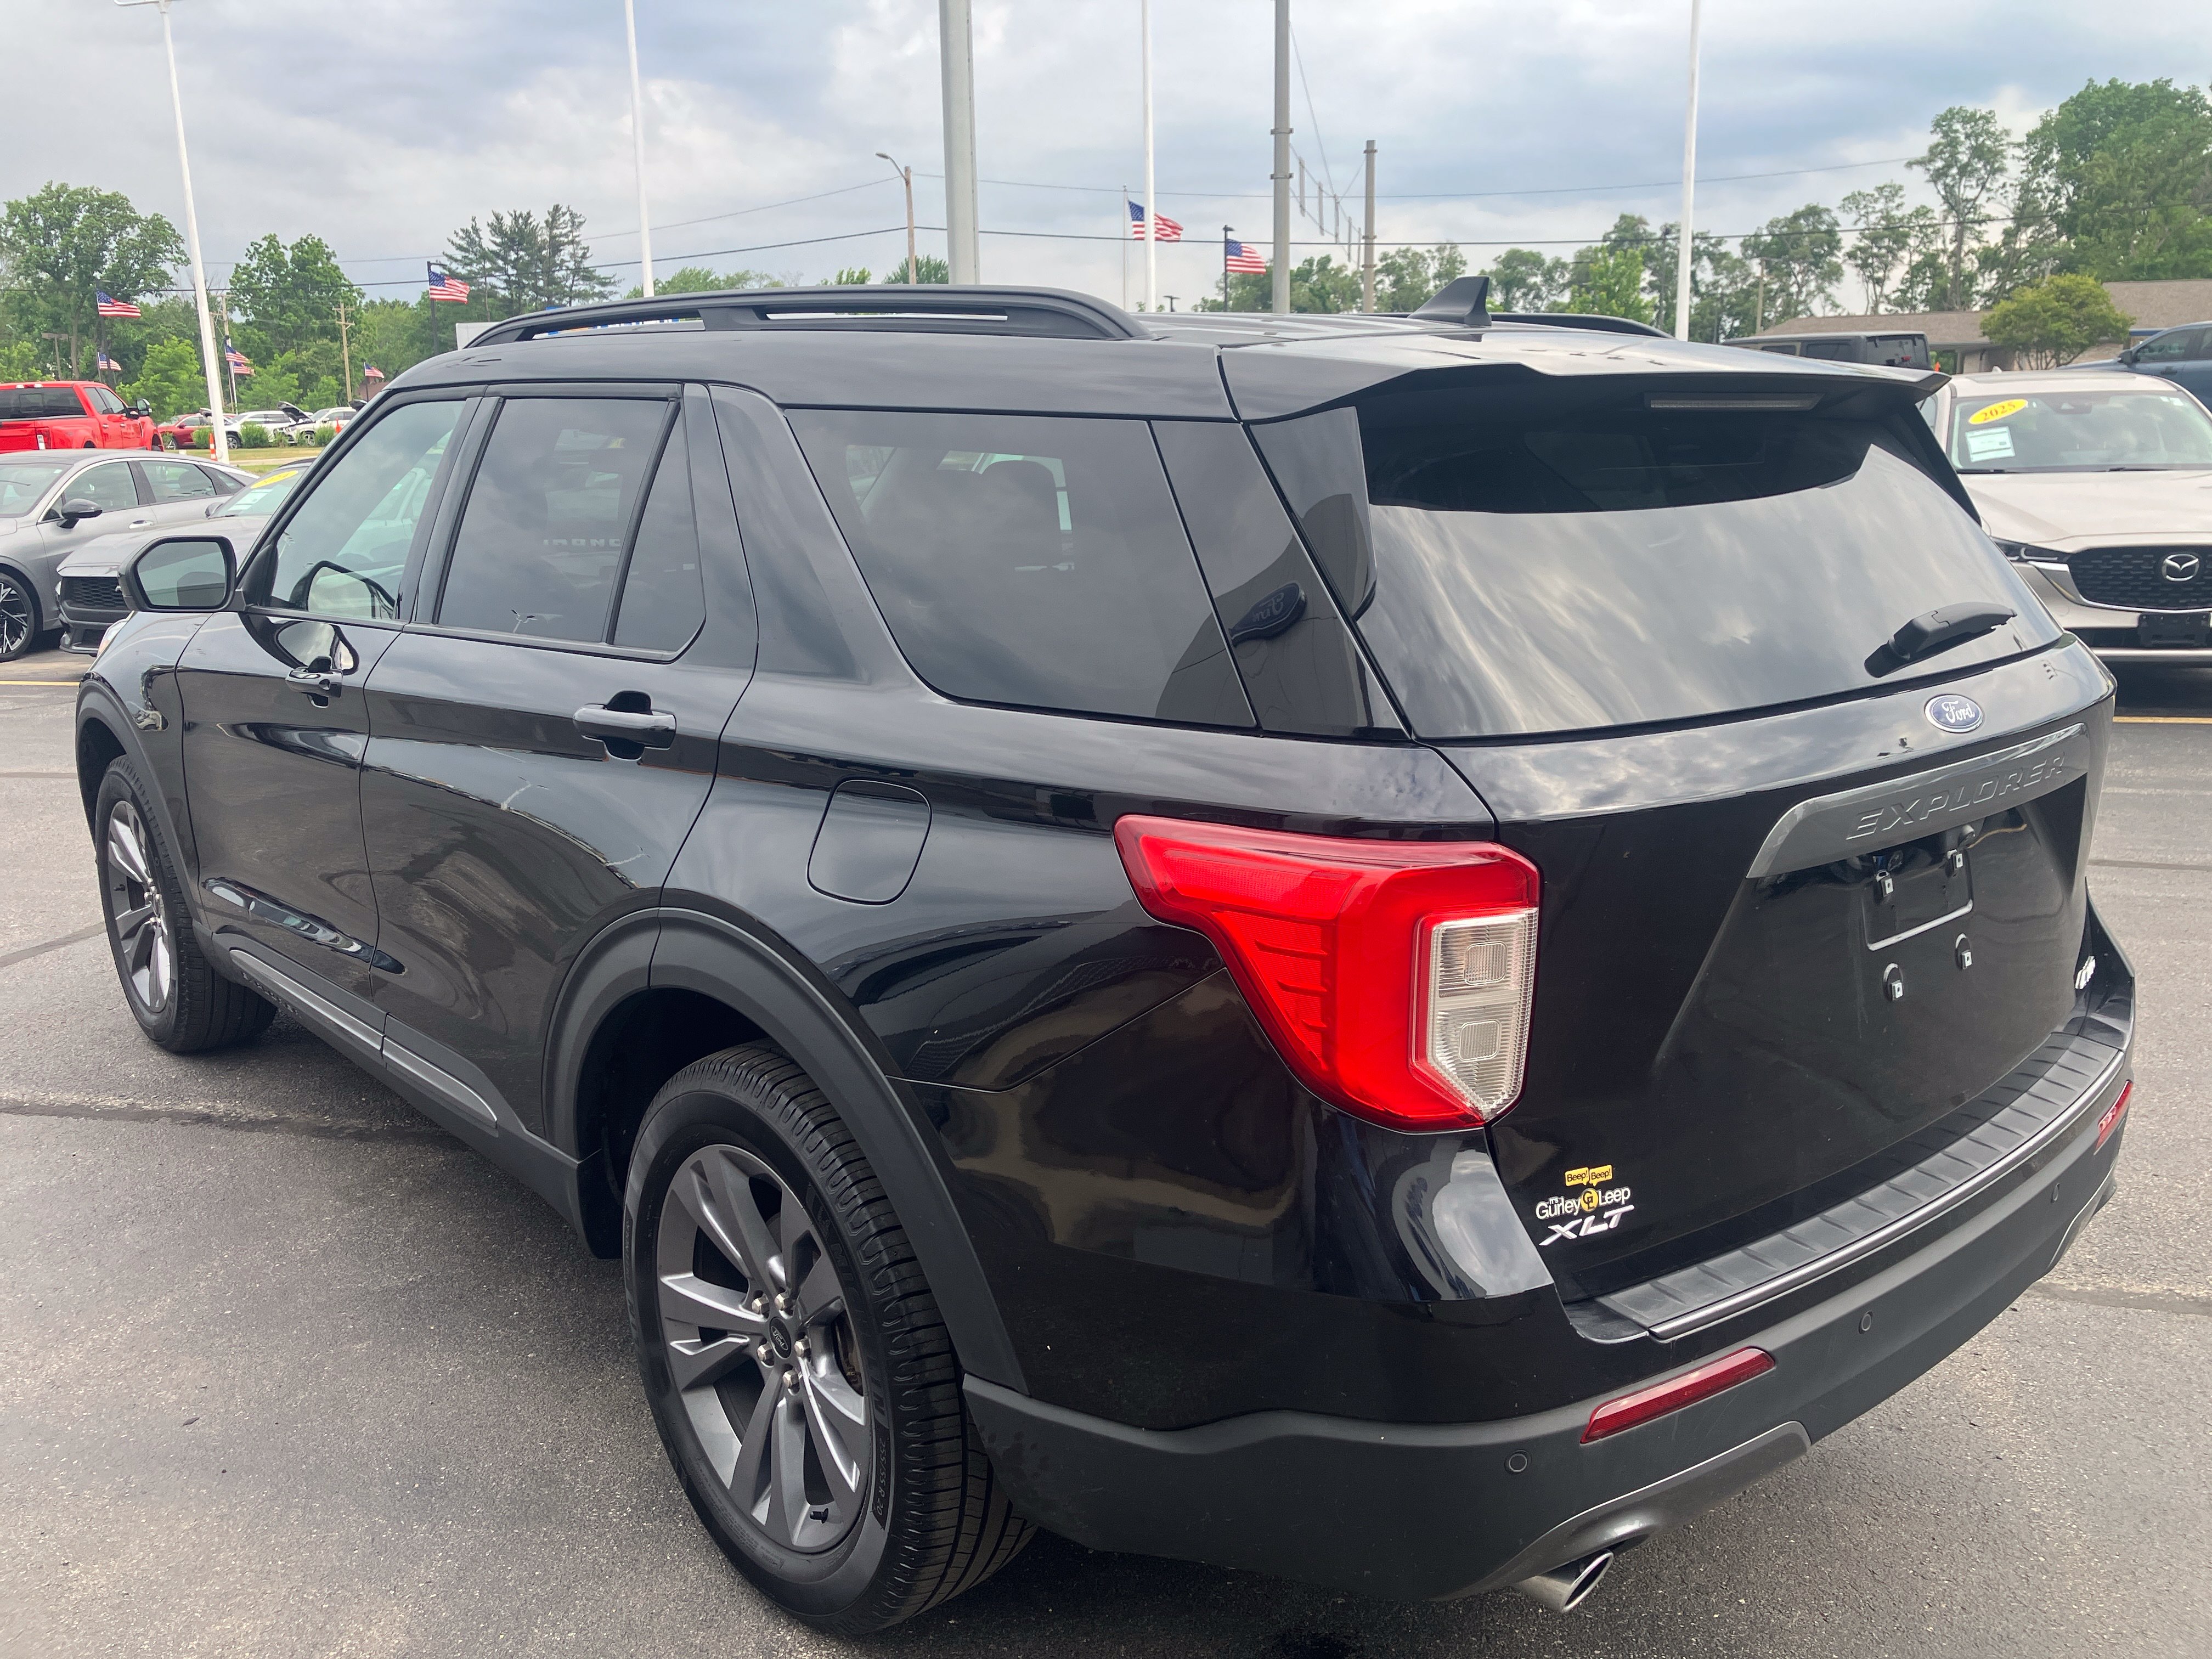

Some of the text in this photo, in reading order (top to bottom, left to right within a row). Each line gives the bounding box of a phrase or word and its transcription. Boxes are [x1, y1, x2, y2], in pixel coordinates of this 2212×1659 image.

[1980, 403, 2016, 422] 2025
[1941, 700, 1976, 724] Ford
[1846, 751, 2065, 840] EXPLORER
[1567, 1168, 1611, 1182] Beep! Beep!
[1536, 1197, 1581, 1219] Gurley
[1599, 1187, 1630, 1205] Leep
[1538, 1204, 1635, 1246] XLT
